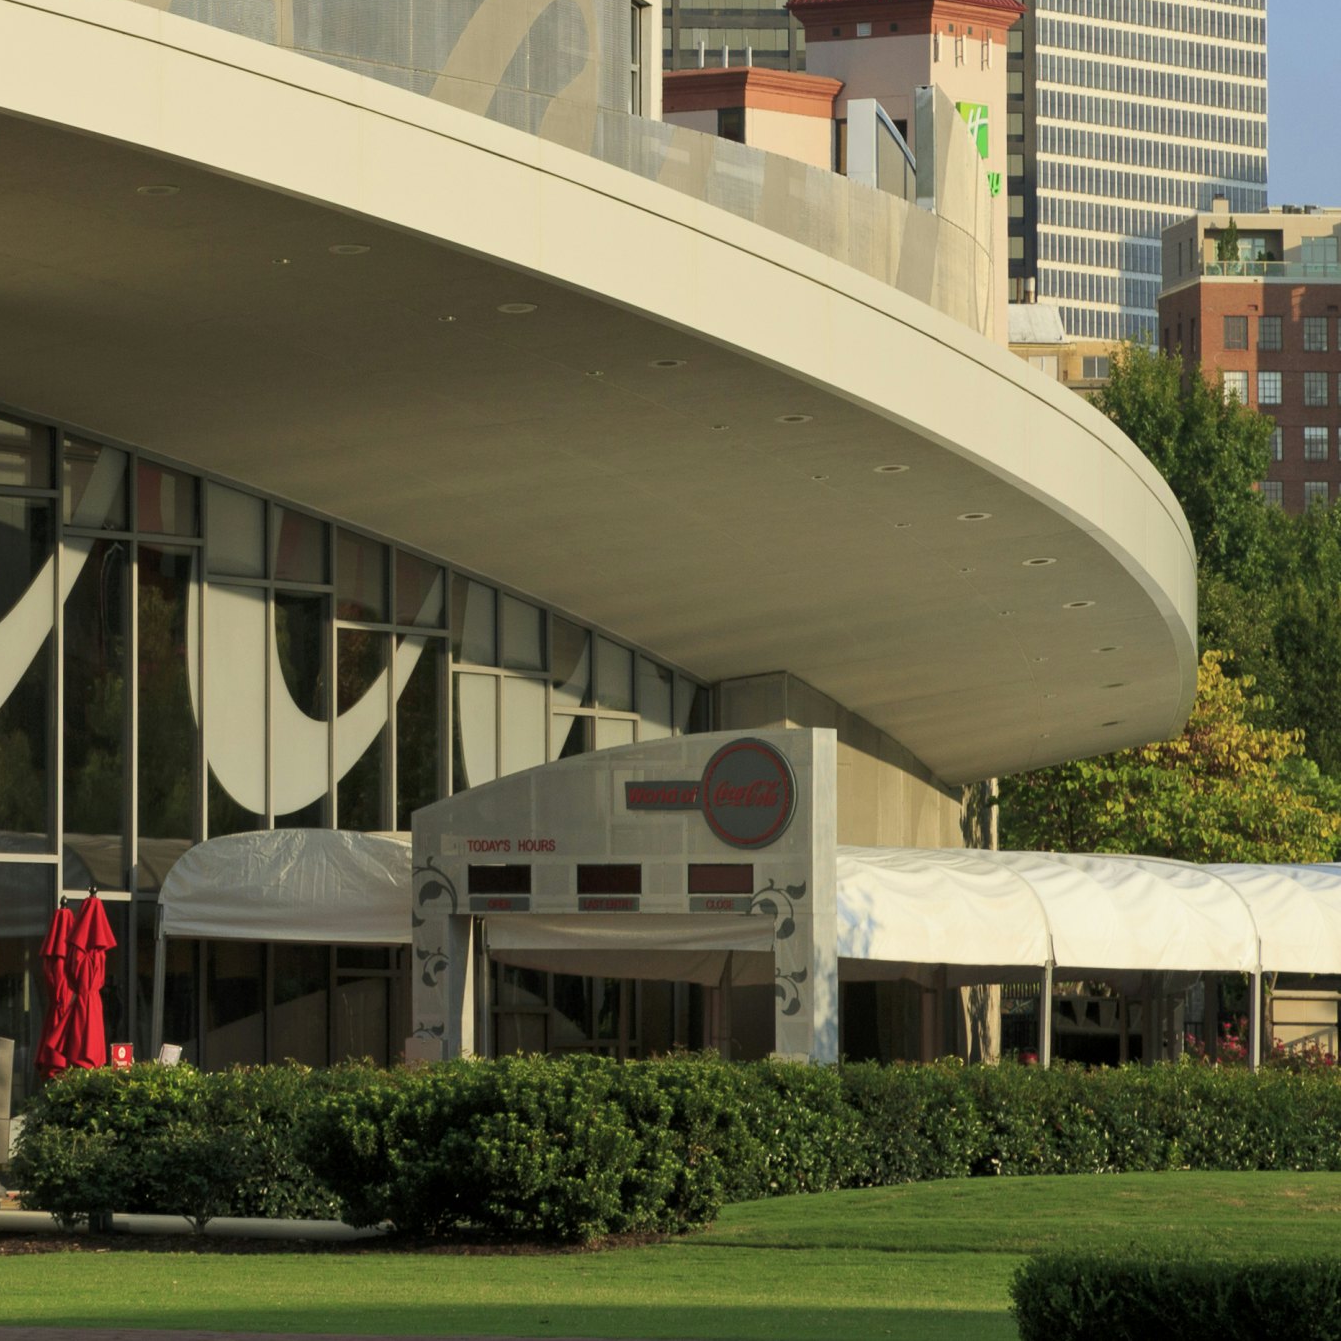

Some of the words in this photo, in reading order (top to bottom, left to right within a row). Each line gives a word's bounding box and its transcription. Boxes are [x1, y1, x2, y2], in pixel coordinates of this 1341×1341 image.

[628, 785, 679, 804] World
[680, 785, 700, 804] of
[713, 779, 780, 808] Coca-Cola
[467, 839, 512, 853] TODAY'S
[518, 839, 556, 853] HOURS
[705, 898, 734, 908] CLOSE
